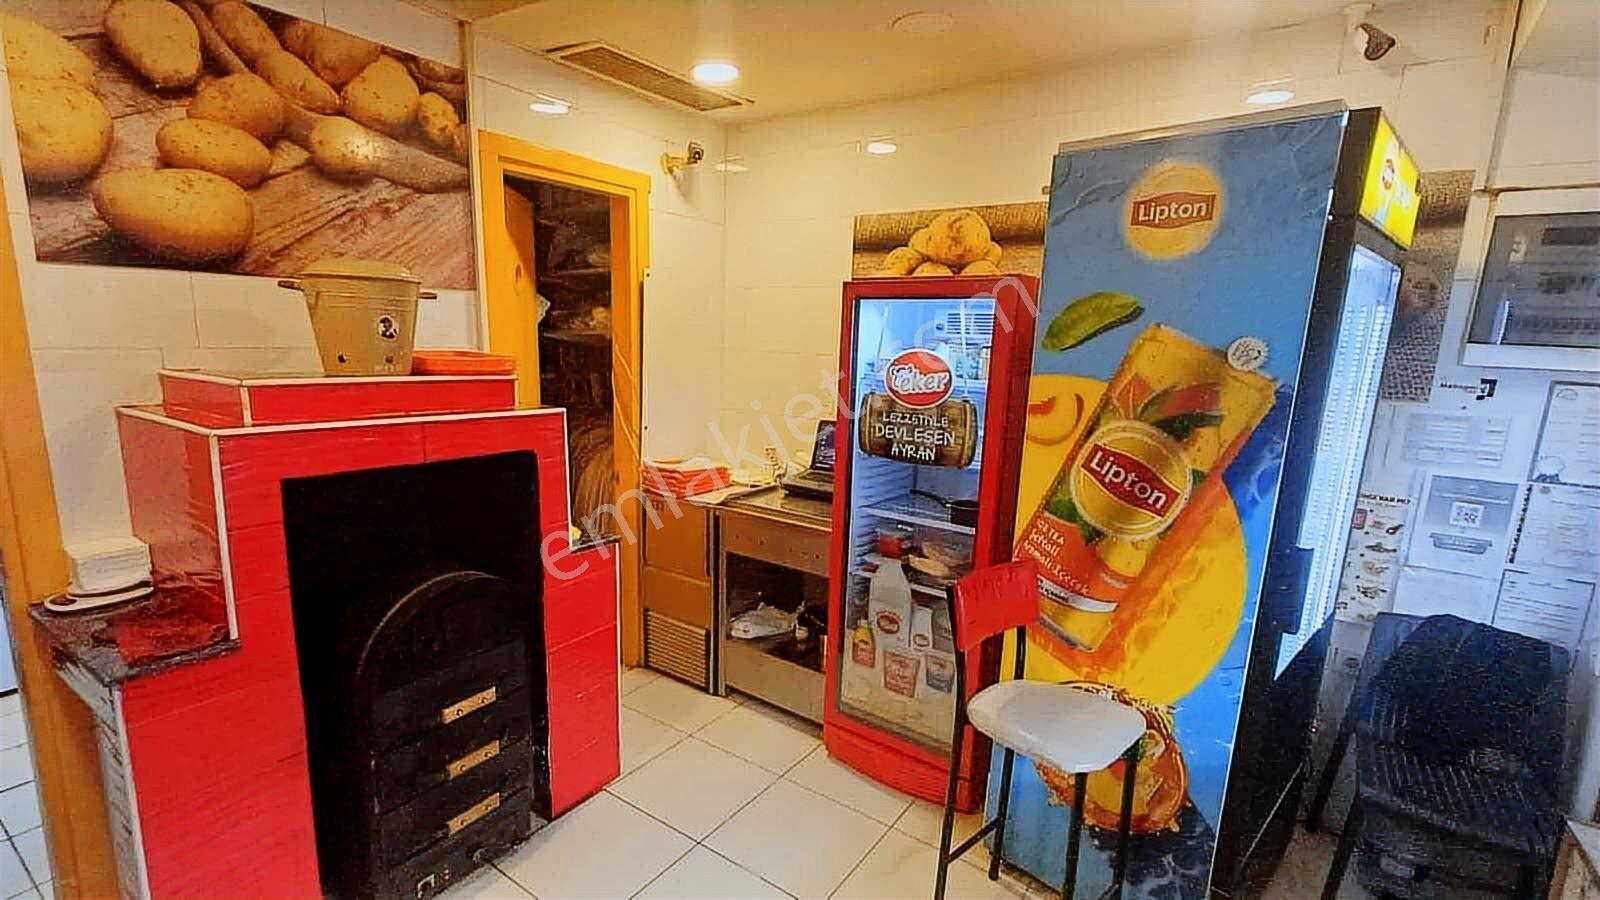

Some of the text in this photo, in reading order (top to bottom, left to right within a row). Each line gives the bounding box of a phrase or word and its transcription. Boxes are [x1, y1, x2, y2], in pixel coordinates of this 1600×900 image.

[1138, 201, 1207, 223] Lipton
[875, 423, 957, 447] DEVLESEN
[891, 442, 937, 461] AYRAN
[1089, 450, 1168, 510] Lipton
